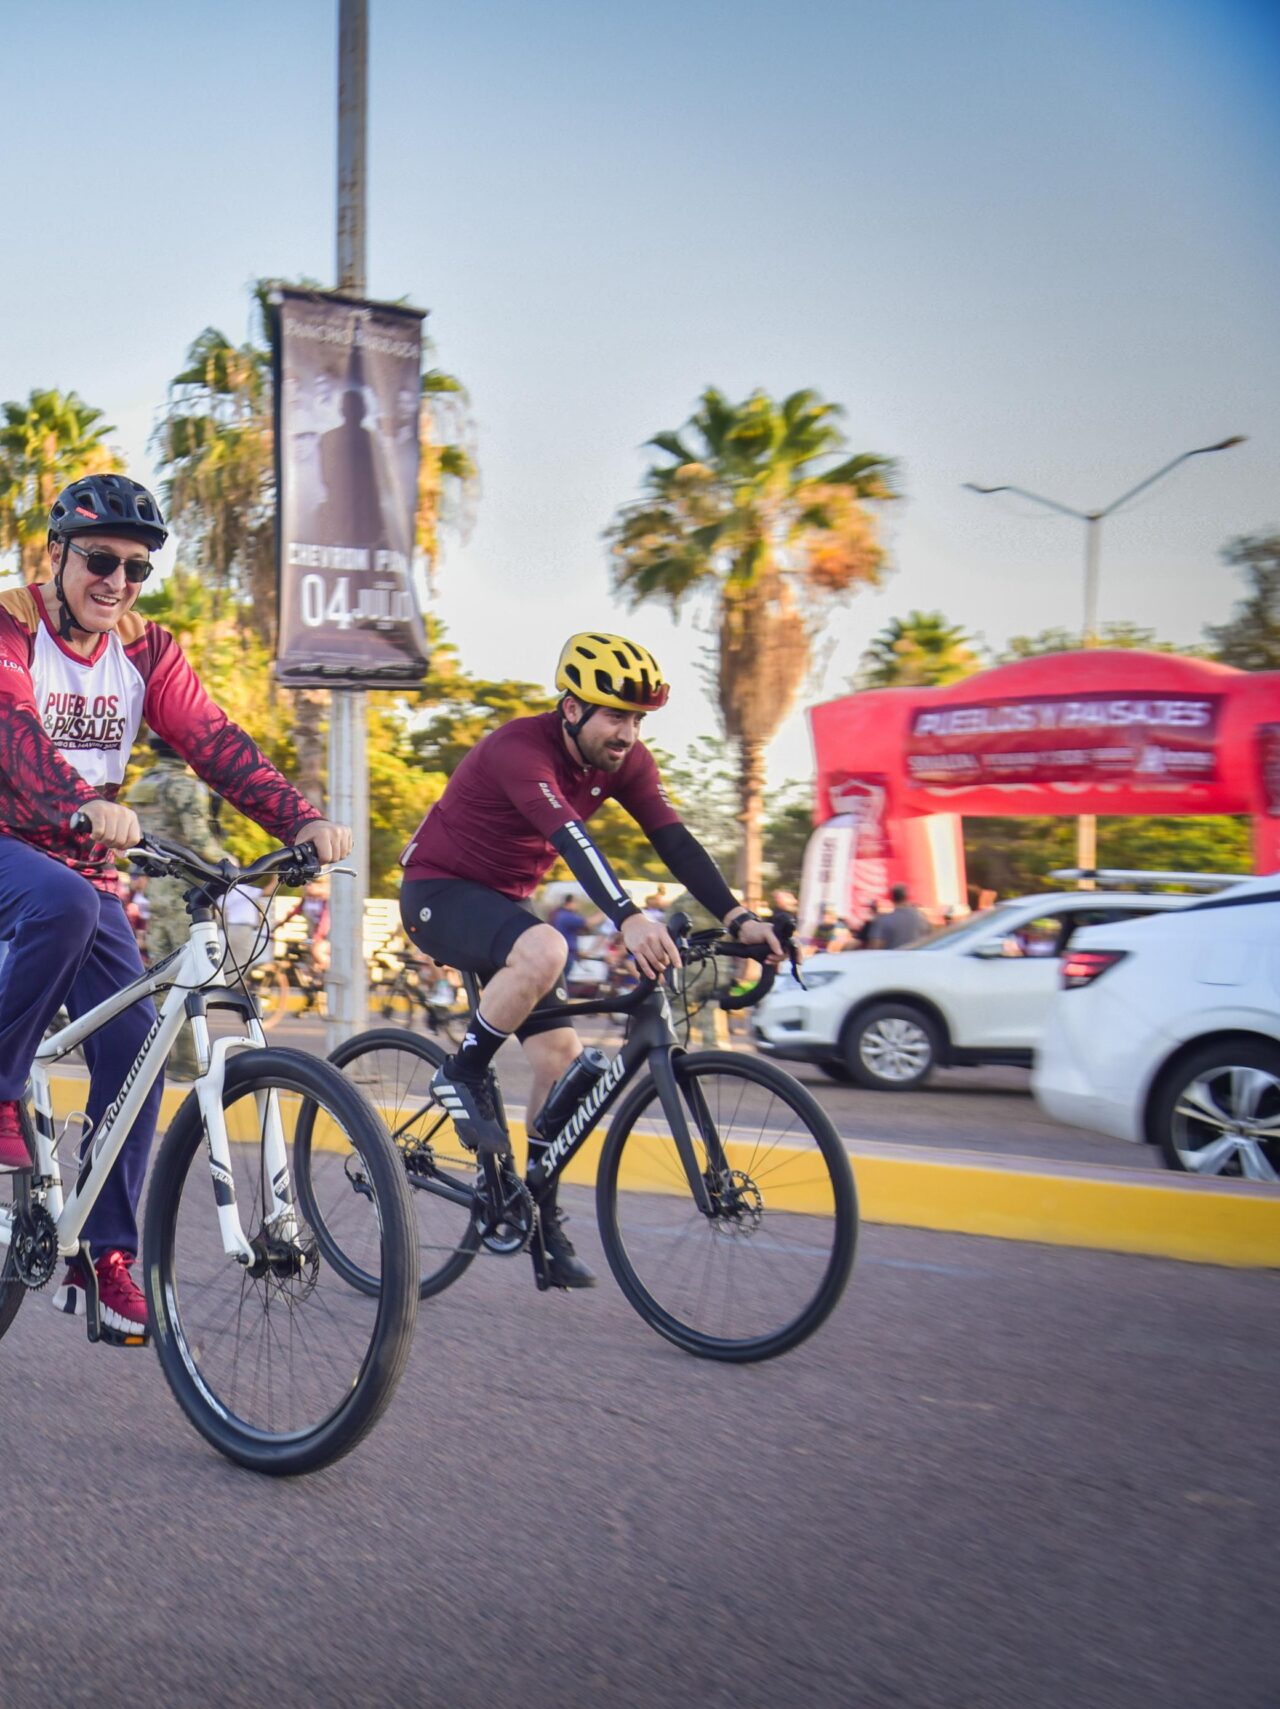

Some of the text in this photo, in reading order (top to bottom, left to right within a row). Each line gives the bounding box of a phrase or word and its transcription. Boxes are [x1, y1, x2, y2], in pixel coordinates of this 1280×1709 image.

[301, 573, 352, 630] 04
[44, 692, 119, 719] PUEBLOS
[913, 699, 1212, 737] PUEBLOS Y PAISAJES
[43, 714, 126, 741] & PAISAJES
[540, 1053, 626, 1178] SPECIALIZED
